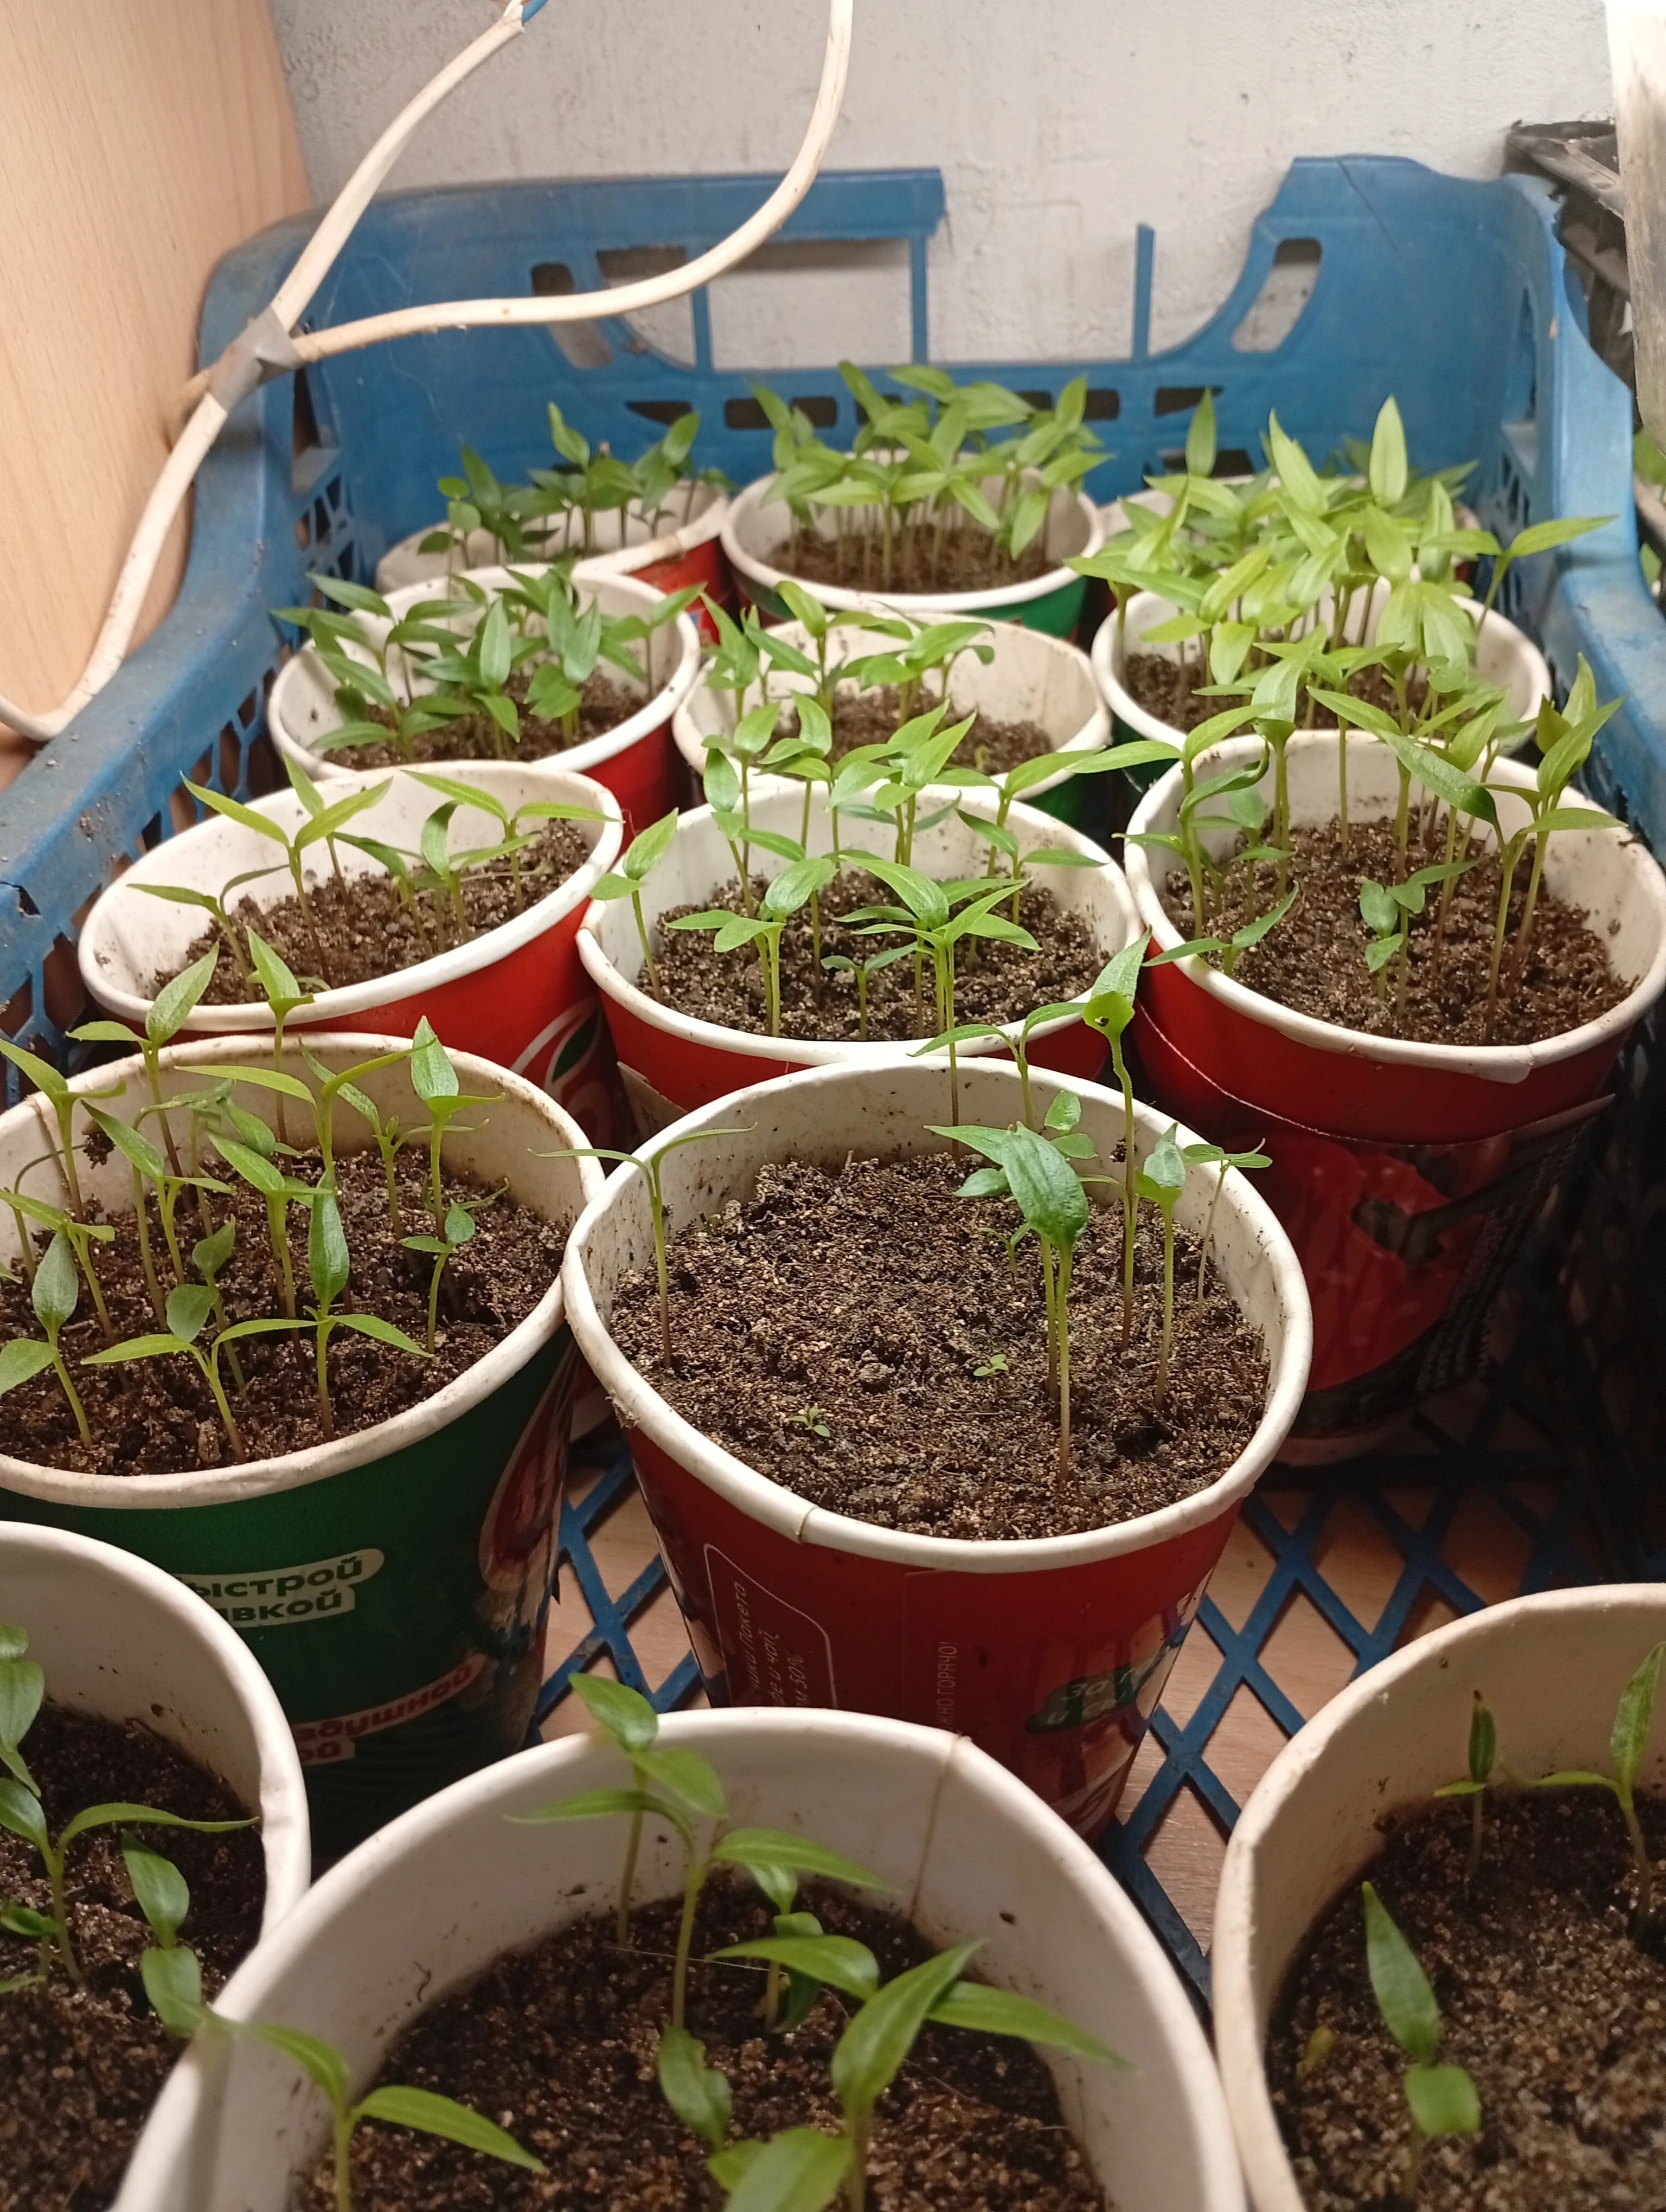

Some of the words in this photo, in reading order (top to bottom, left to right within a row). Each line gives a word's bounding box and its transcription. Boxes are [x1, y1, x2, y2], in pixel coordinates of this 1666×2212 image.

[188, 1555, 363, 1597] ыстрой
[218, 1588, 342, 1622] вкой
[937, 1641, 957, 1695] ГОРЯЧО!
